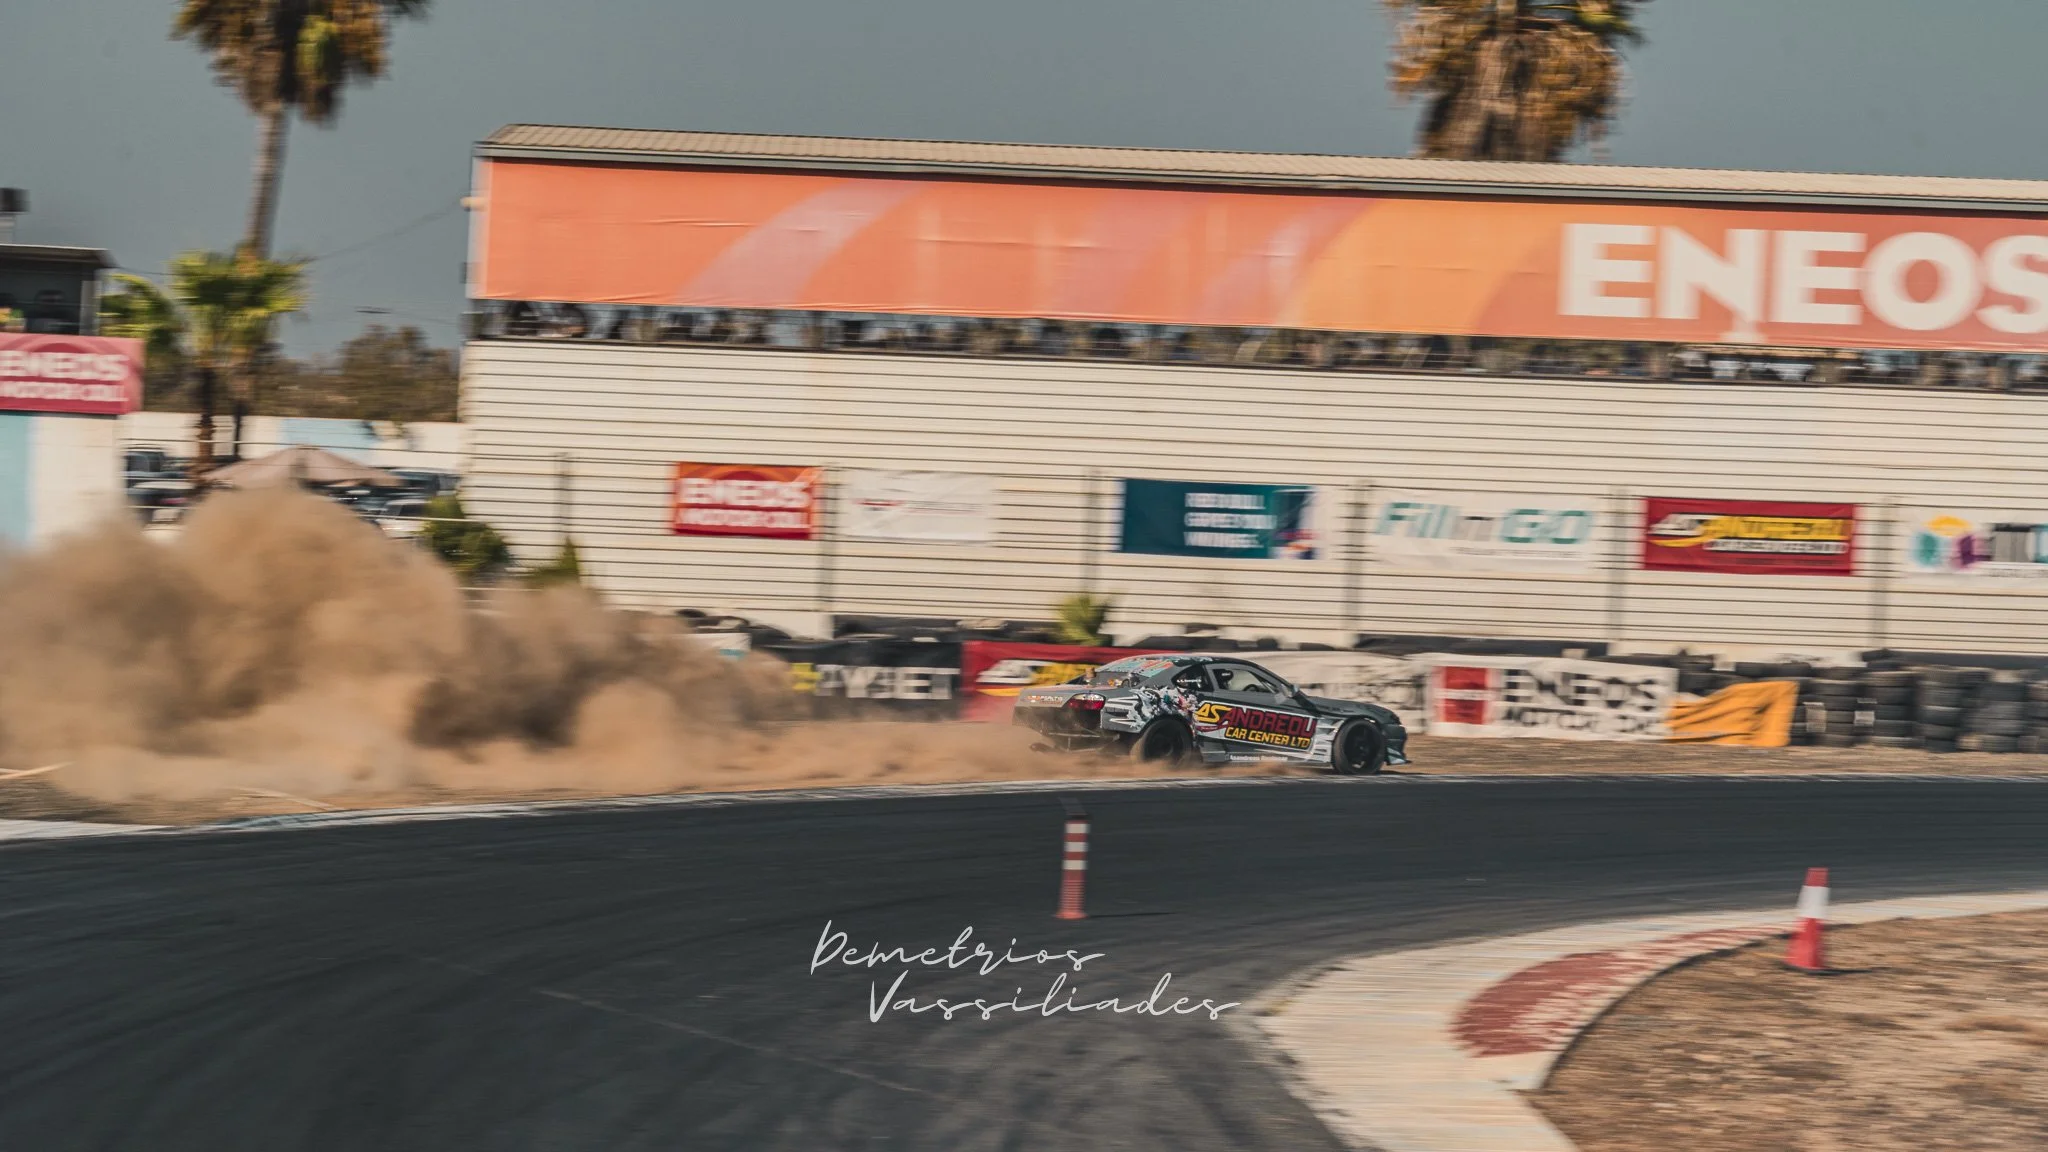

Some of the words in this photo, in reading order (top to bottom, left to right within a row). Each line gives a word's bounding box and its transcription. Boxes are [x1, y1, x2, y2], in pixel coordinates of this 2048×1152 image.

[1558, 223, 2048, 334] ENEOS
[679, 477, 809, 507] ENEOS
[1500, 668, 1660, 712] ENEOS
[1221, 707, 1318, 738] ANDREOU
[1225, 727, 1247, 740] CAR
[1248, 730, 1290, 746] CENTER
[1291, 737, 1312, 749] LTD
